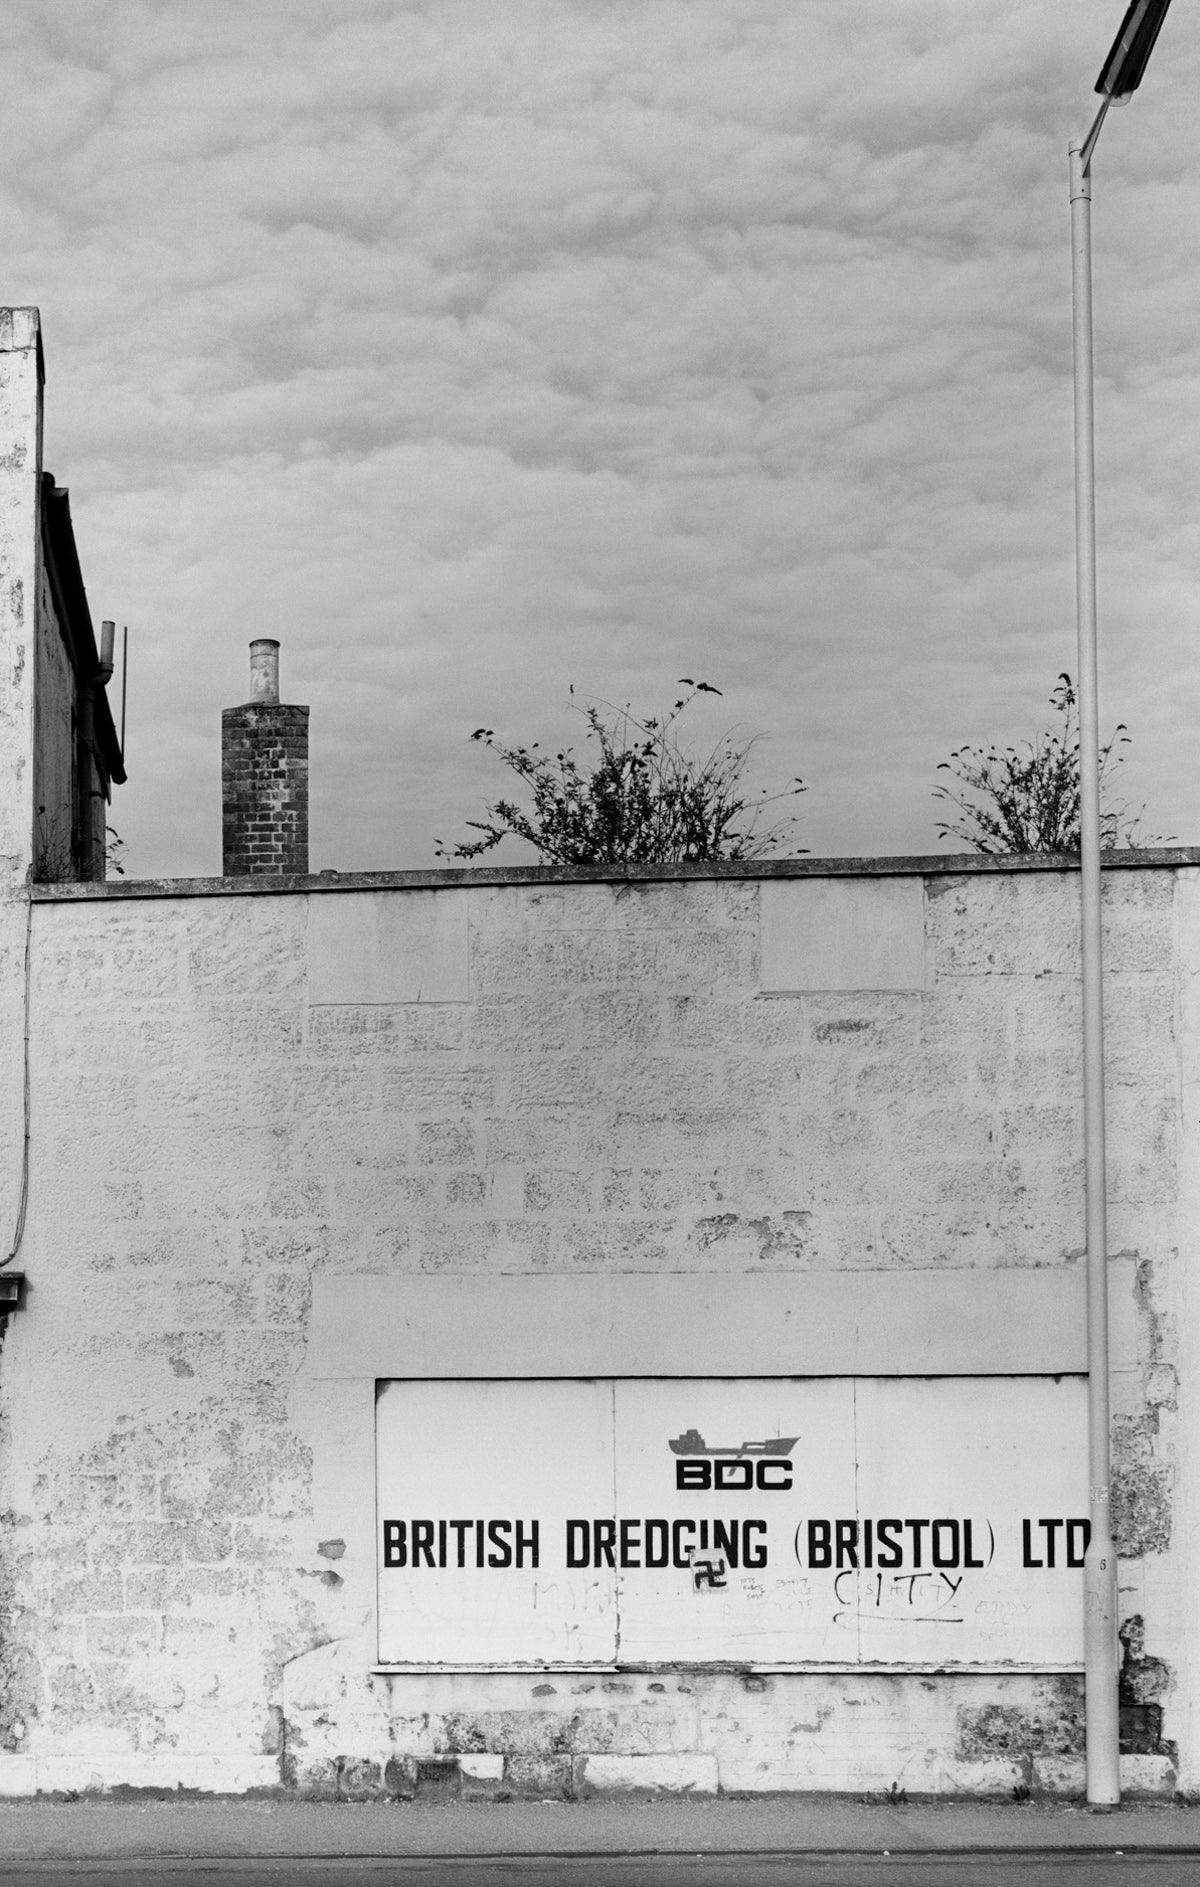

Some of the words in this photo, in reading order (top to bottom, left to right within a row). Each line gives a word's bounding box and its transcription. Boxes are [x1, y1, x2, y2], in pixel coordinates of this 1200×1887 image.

[675, 1459, 793, 1491] BDC
[383, 1518, 540, 1569] BRITISH
[566, 1518, 768, 1569] DREDGING
[794, 1518, 995, 1569] (BRISTOL)
[1022, 1518, 1092, 1569] LTD
[1099, 1558, 1108, 1571] 5
[833, 1570, 964, 1608] CITY
